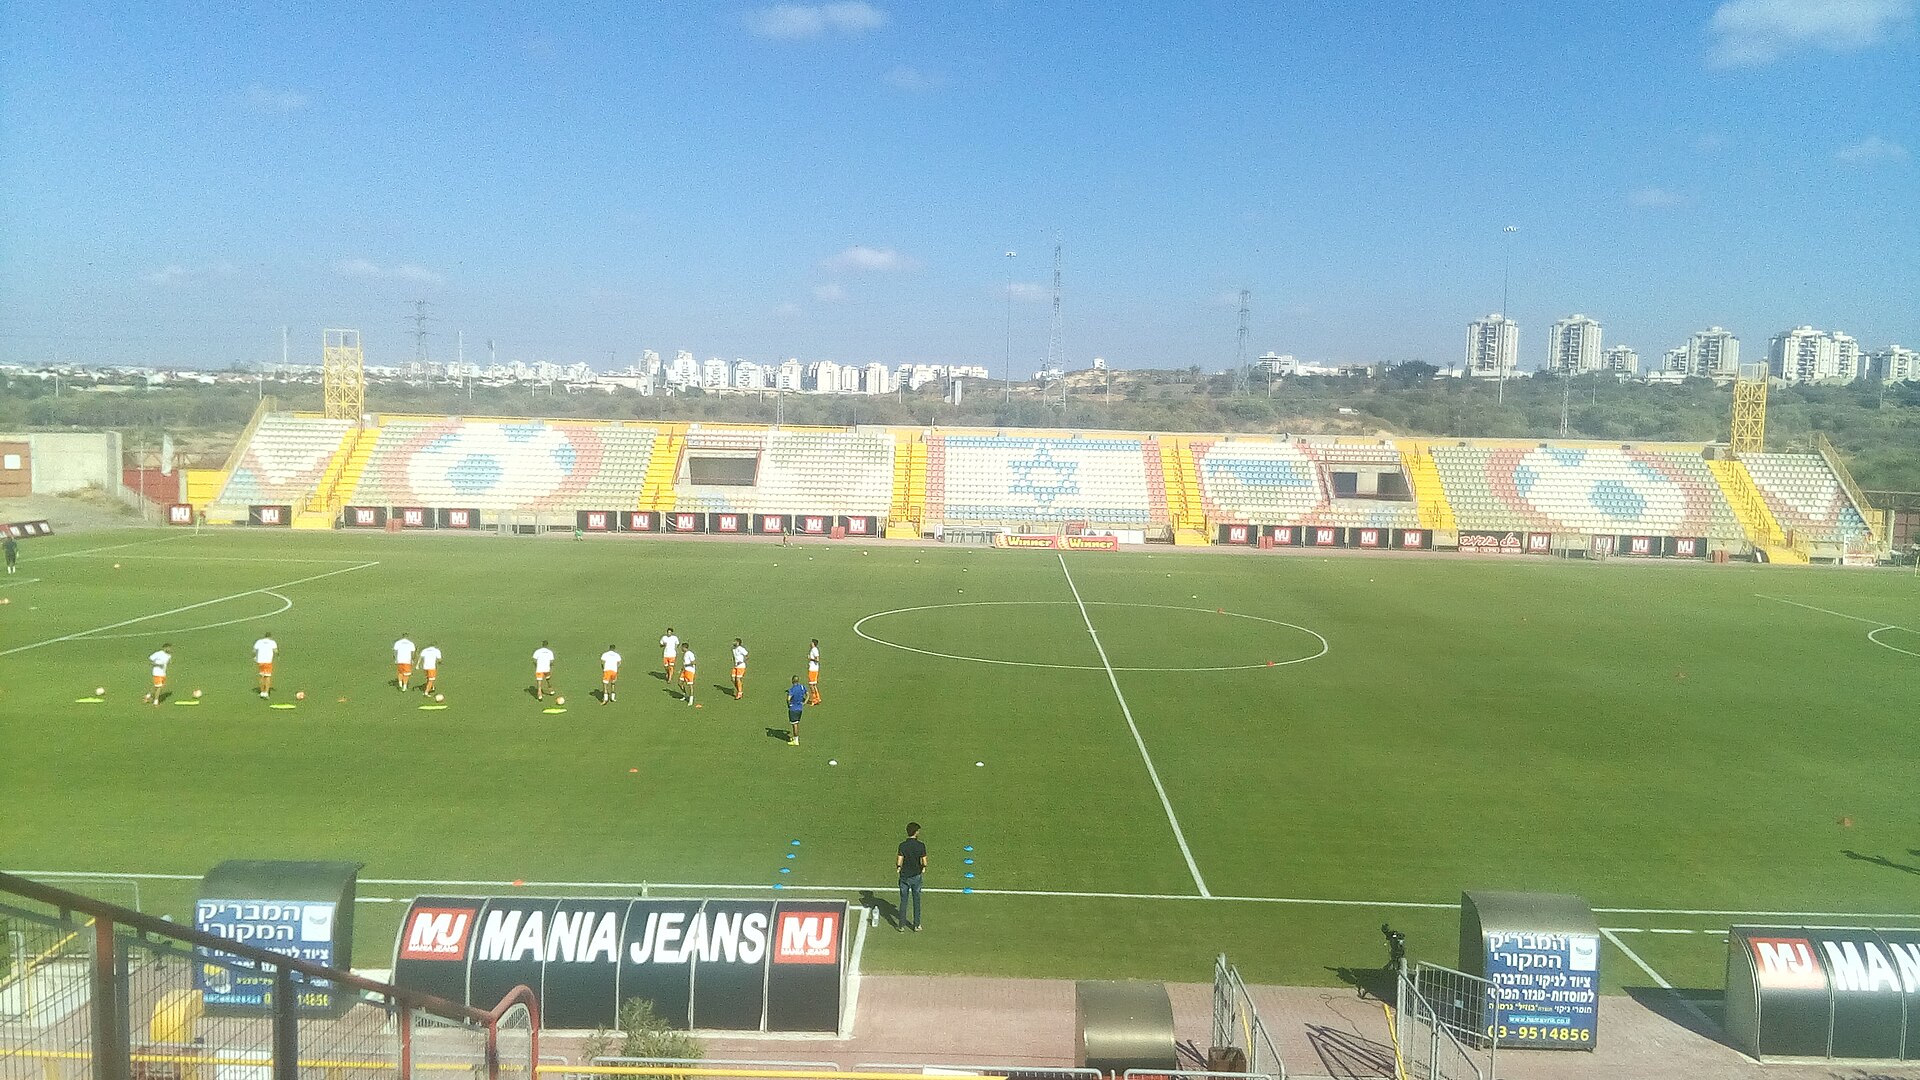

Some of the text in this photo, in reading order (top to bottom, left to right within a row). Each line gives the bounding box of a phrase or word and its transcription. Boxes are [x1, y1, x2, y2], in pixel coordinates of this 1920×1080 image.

[172, 507, 190, 521] MJ
[261, 509, 278, 523] MJ
[358, 510, 373, 523] MJ
[405, 511, 422, 525] MJ
[452, 512, 467, 524] MJ
[590, 515, 605, 527] MJ
[633, 515, 648, 528] MJ
[678, 516, 694, 529] MJ
[721, 517, 737, 530] MJ
[765, 516, 780, 530] MJ
[807, 518, 822, 531] MJ
[850, 518, 865, 531] MJ
[1231, 528, 1245, 540] MJ
[1275, 530, 1289, 542] MJ
[1318, 530, 1332, 543] MJ
[1362, 532, 1376, 544] MJ
[1405, 533, 1419, 545] MJ
[1531, 536, 1547, 549] MJ
[1633, 539, 1648, 552] MJ
[1678, 541, 1693, 553] MJ
[198, 904, 300, 923] המבריק
[202, 923, 294, 943] המקורי
[409, 912, 468, 945] MJ
[781, 917, 833, 949] MJ
[478, 910, 768, 965] MANIA JEANS
[1489, 934, 1567, 952] המבריק
[302, 948, 329, 959] ציוד
[1756, 942, 1814, 973] MJ
[1494, 952, 1561, 971] המקורי
[1493, 972, 1591, 988] ציוד לניקוי והדברה
[1554, 1004, 1571, 1014] ניקוי
[1572, 1005, 1592, 1014] חומרי
[1487, 1025, 1590, 1041] 03-9514856
